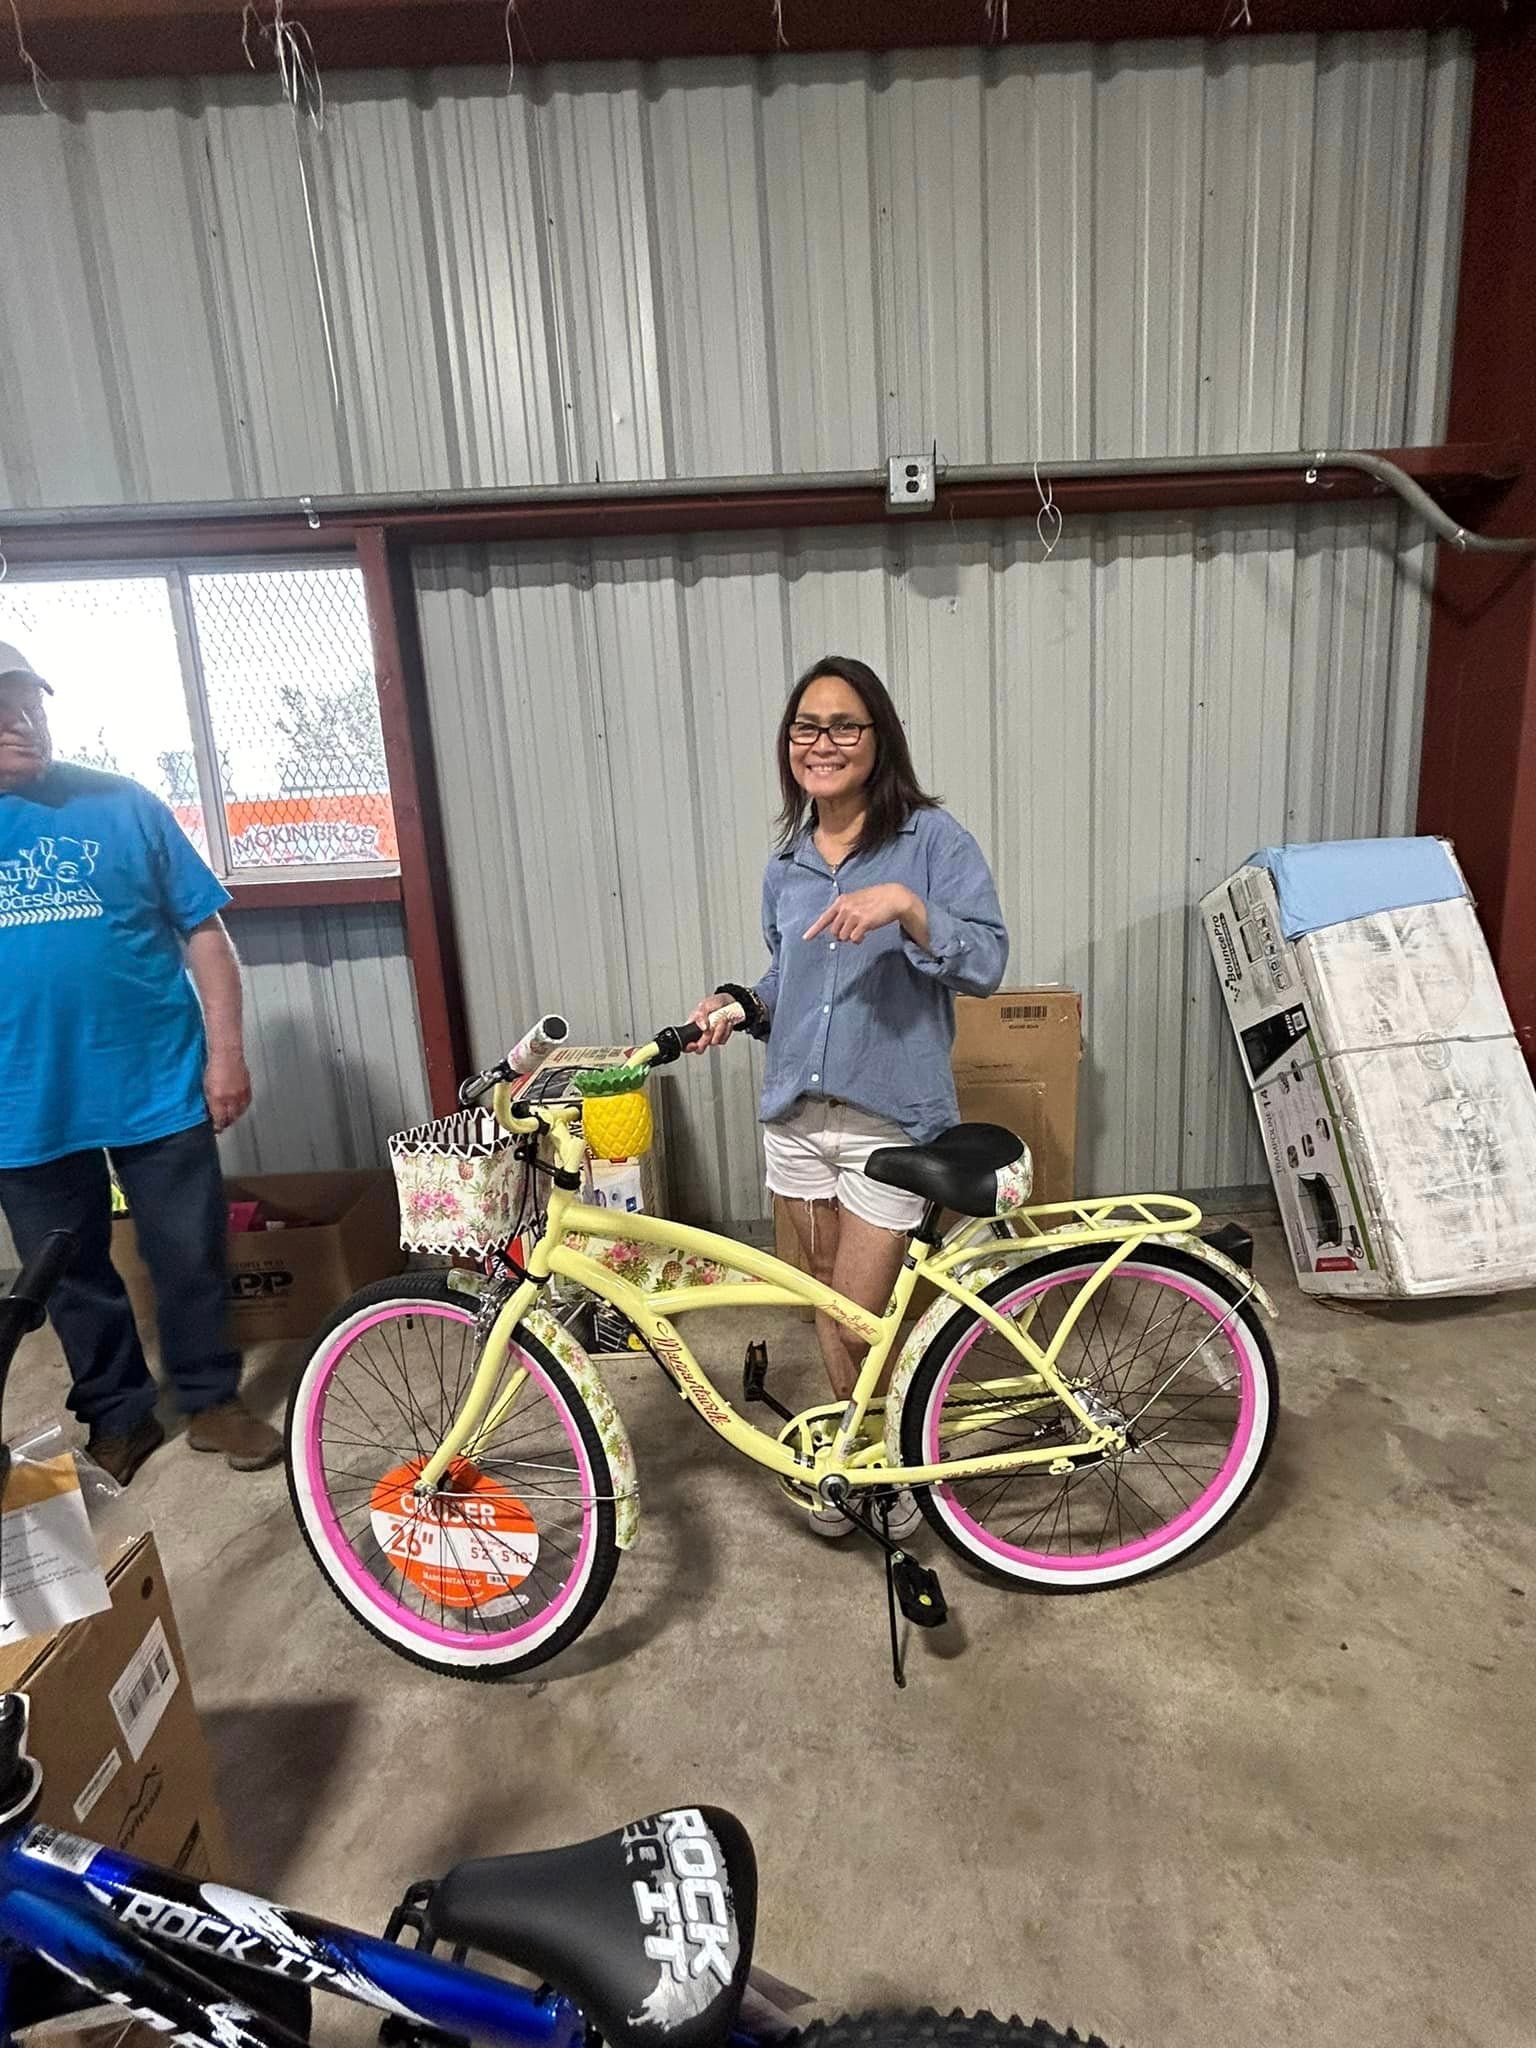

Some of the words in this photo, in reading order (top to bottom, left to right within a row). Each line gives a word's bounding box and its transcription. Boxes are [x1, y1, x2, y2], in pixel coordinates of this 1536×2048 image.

[234, 825, 308, 853] MOKIN
[315, 825, 377, 845] BROS
[0, 866, 41, 881] ALITY
[0, 888, 89, 911] OCESSORS
[1212, 915, 1237, 982] BouncePro
[1260, 1089, 1272, 1108] 14
[401, 1491, 497, 1527] CRUISER
[660, 1809, 733, 1986] ROCK
[118, 1894, 261, 1960] ROCK
[264, 1947, 336, 1983] IT
[632, 1880, 688, 1983] IT
